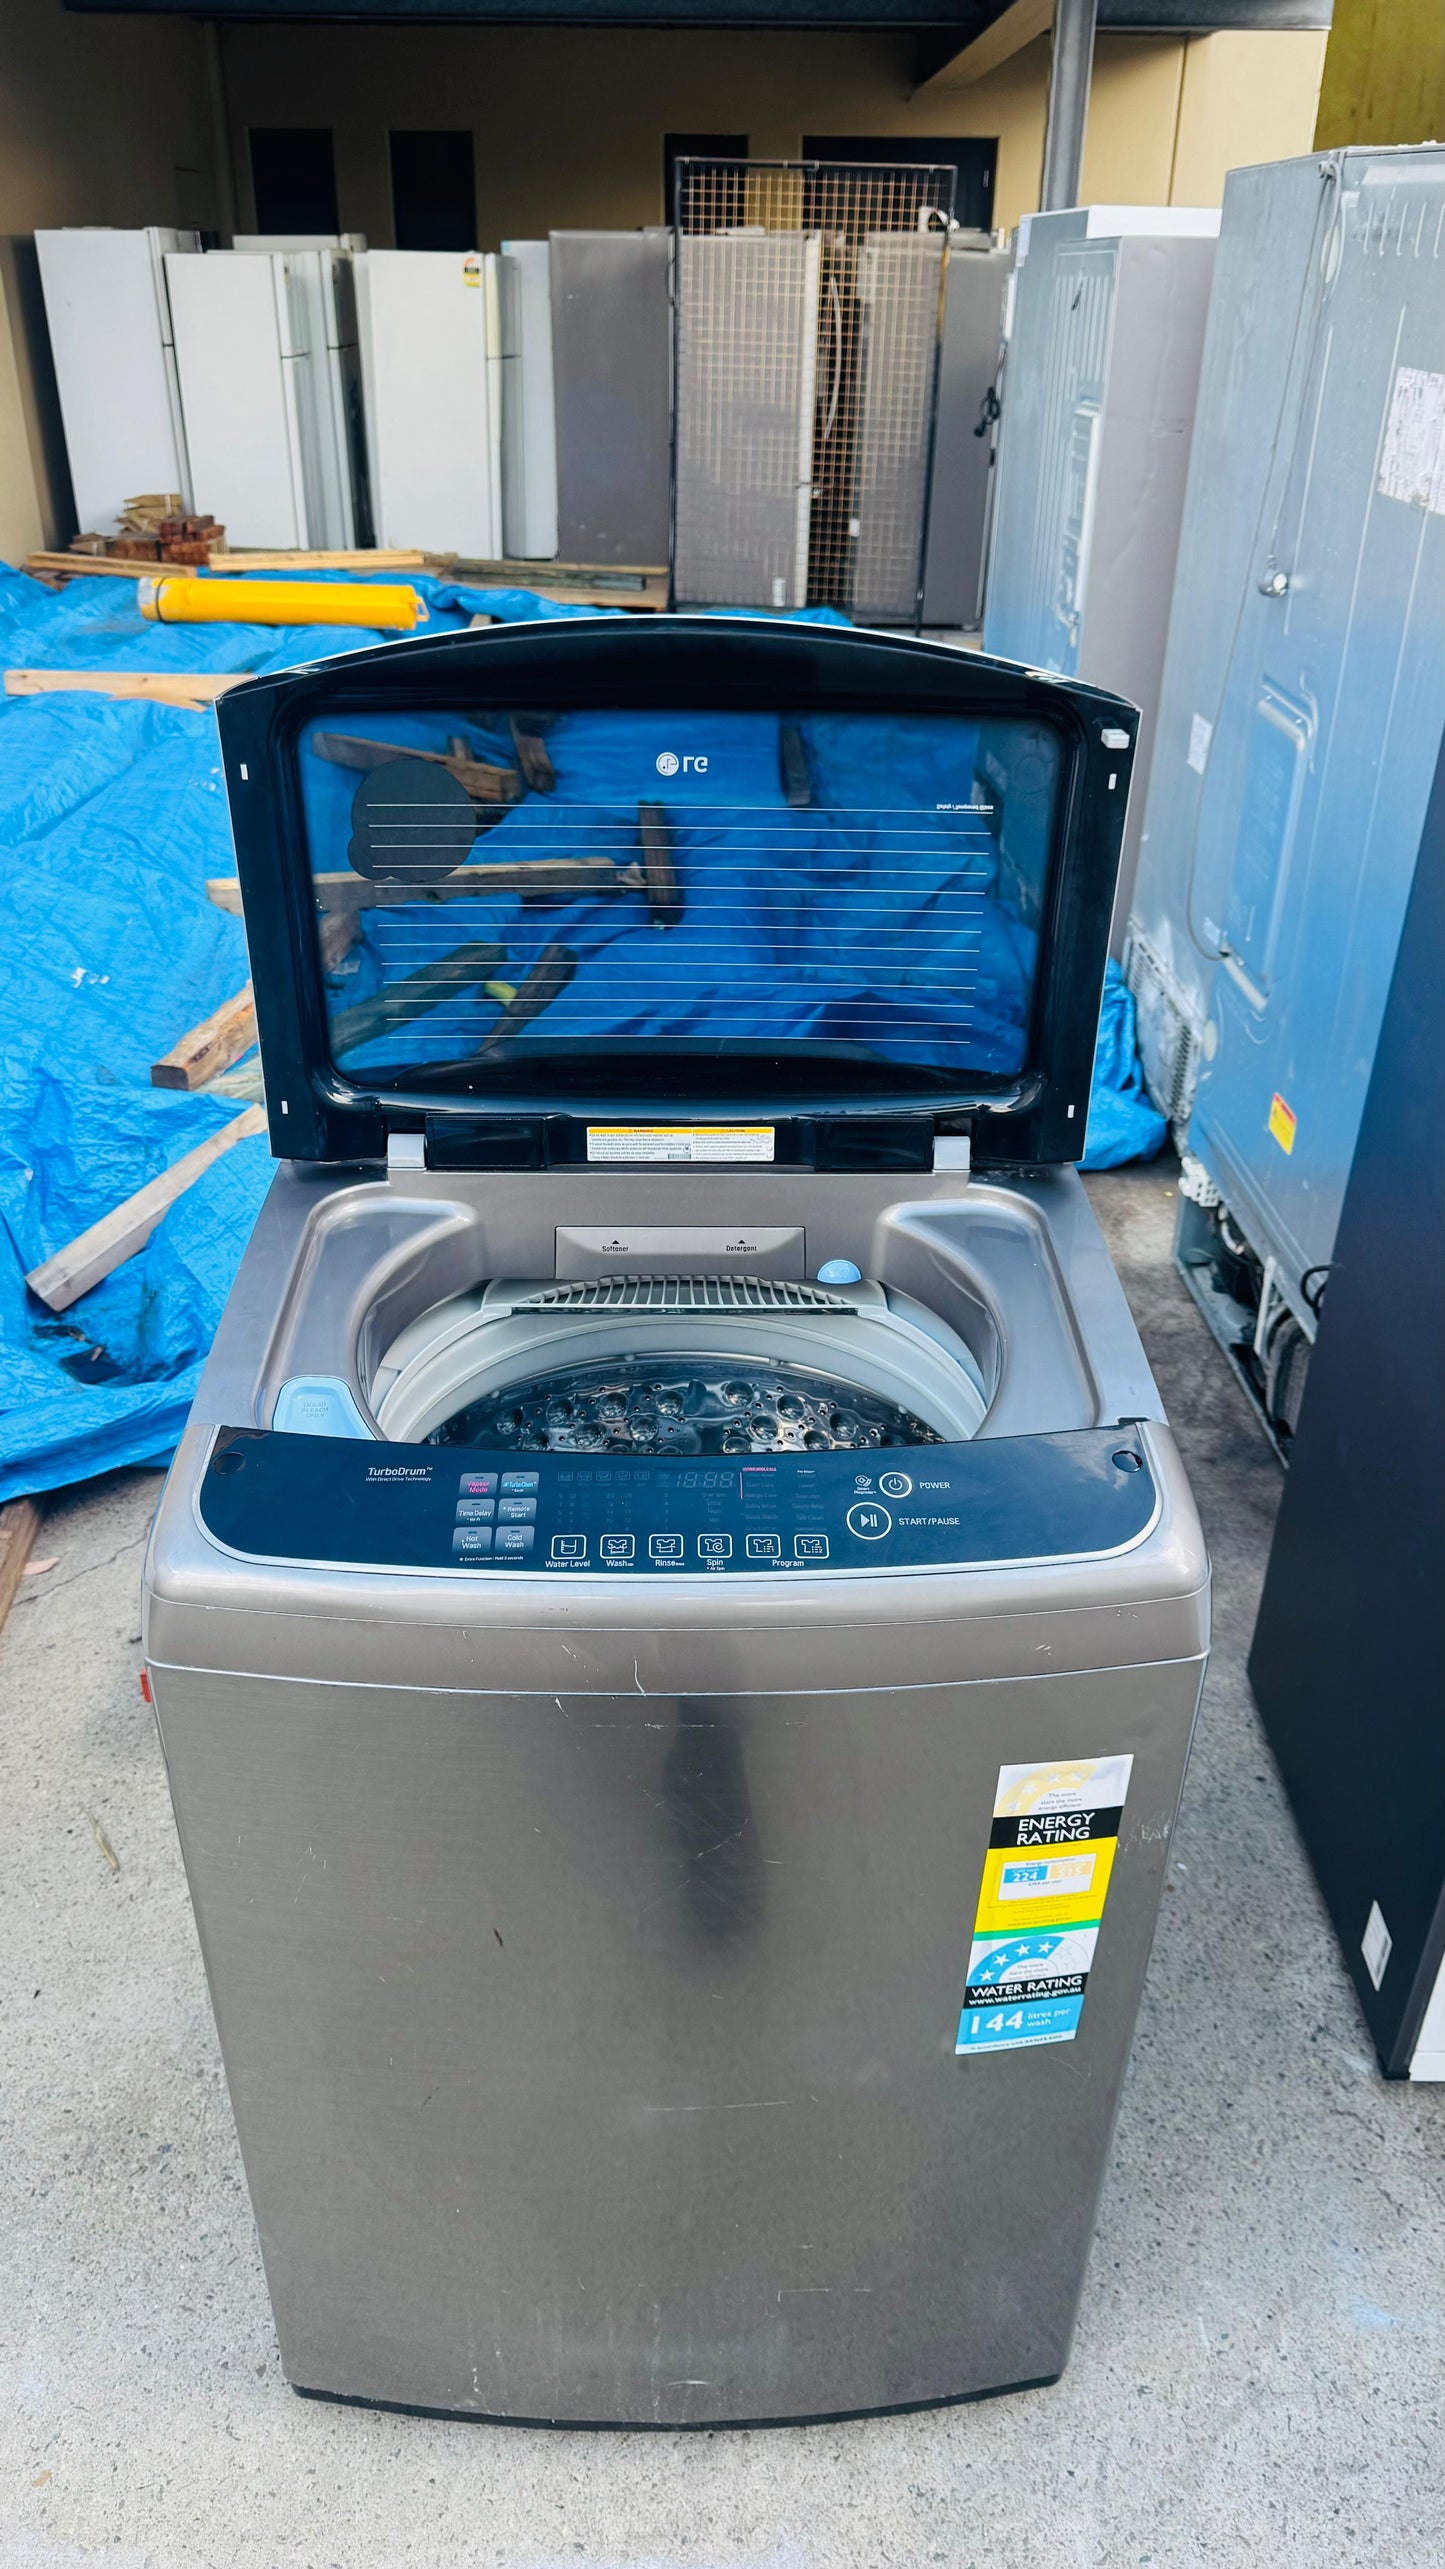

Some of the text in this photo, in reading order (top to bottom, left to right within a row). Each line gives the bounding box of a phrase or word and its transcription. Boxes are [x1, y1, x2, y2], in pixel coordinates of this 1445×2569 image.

[1018, 1812, 1095, 1831] ENERGY
[1017, 1827, 1091, 1845] RATING
[1013, 1872, 1038, 1882] 224
[972, 1976, 1083, 1997] WATER RATING
[968, 1987, 1081, 2006] www.waterrating.gov.au
[971, 2010, 1023, 2034] 144
[1028, 2008, 1072, 2019] litres per
[1027, 2019, 1051, 2028] wash
